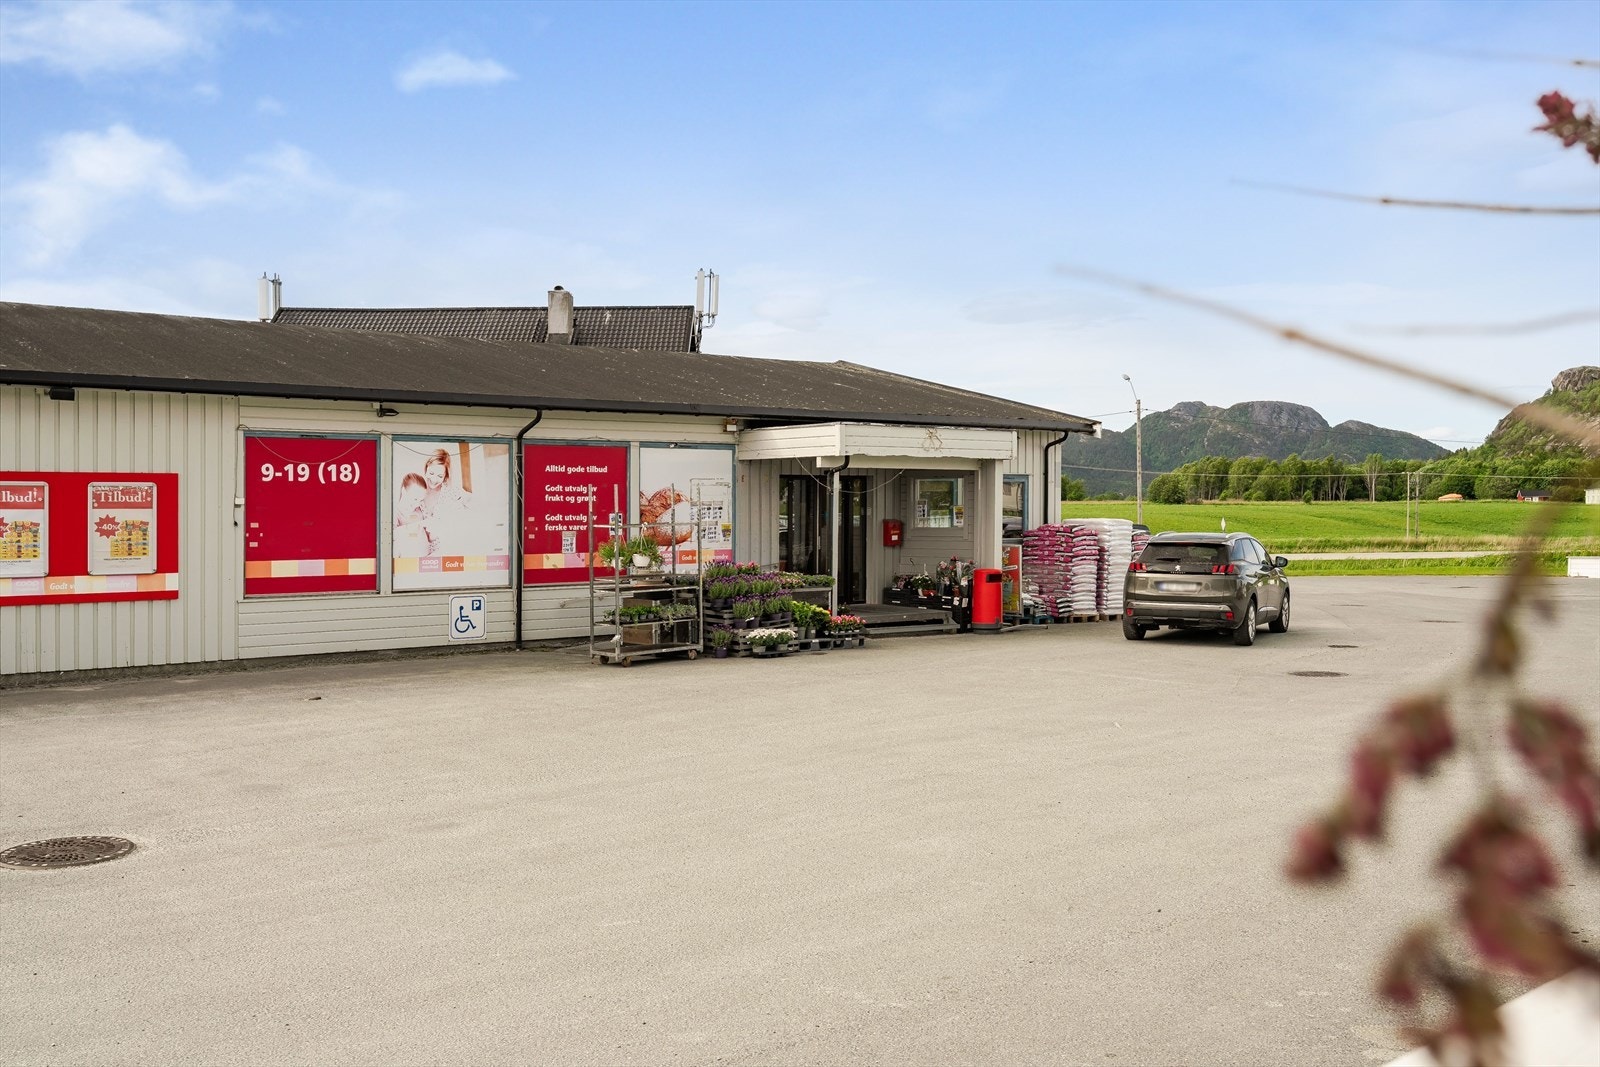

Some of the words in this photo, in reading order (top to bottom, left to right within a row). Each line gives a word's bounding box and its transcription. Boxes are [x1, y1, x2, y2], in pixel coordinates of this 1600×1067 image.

[261, 463, 310, 482] 9-19
[318, 462, 360, 484] (18)
[567, 466, 585, 474] gode
[586, 465, 607, 473] tilbud
[545, 484, 563, 492] Godt
[565, 485, 587, 493] utvalg
[100, 490, 146, 503] Tilbud!
[545, 494, 564, 502] frukt
[565, 496, 575, 504] og
[545, 513, 563, 521] Godt
[565, 514, 587, 522] utvalg
[445, 560, 460, 568] Godt
[49, 582, 68, 591] Godt
[473, 601, 480, 610] P
